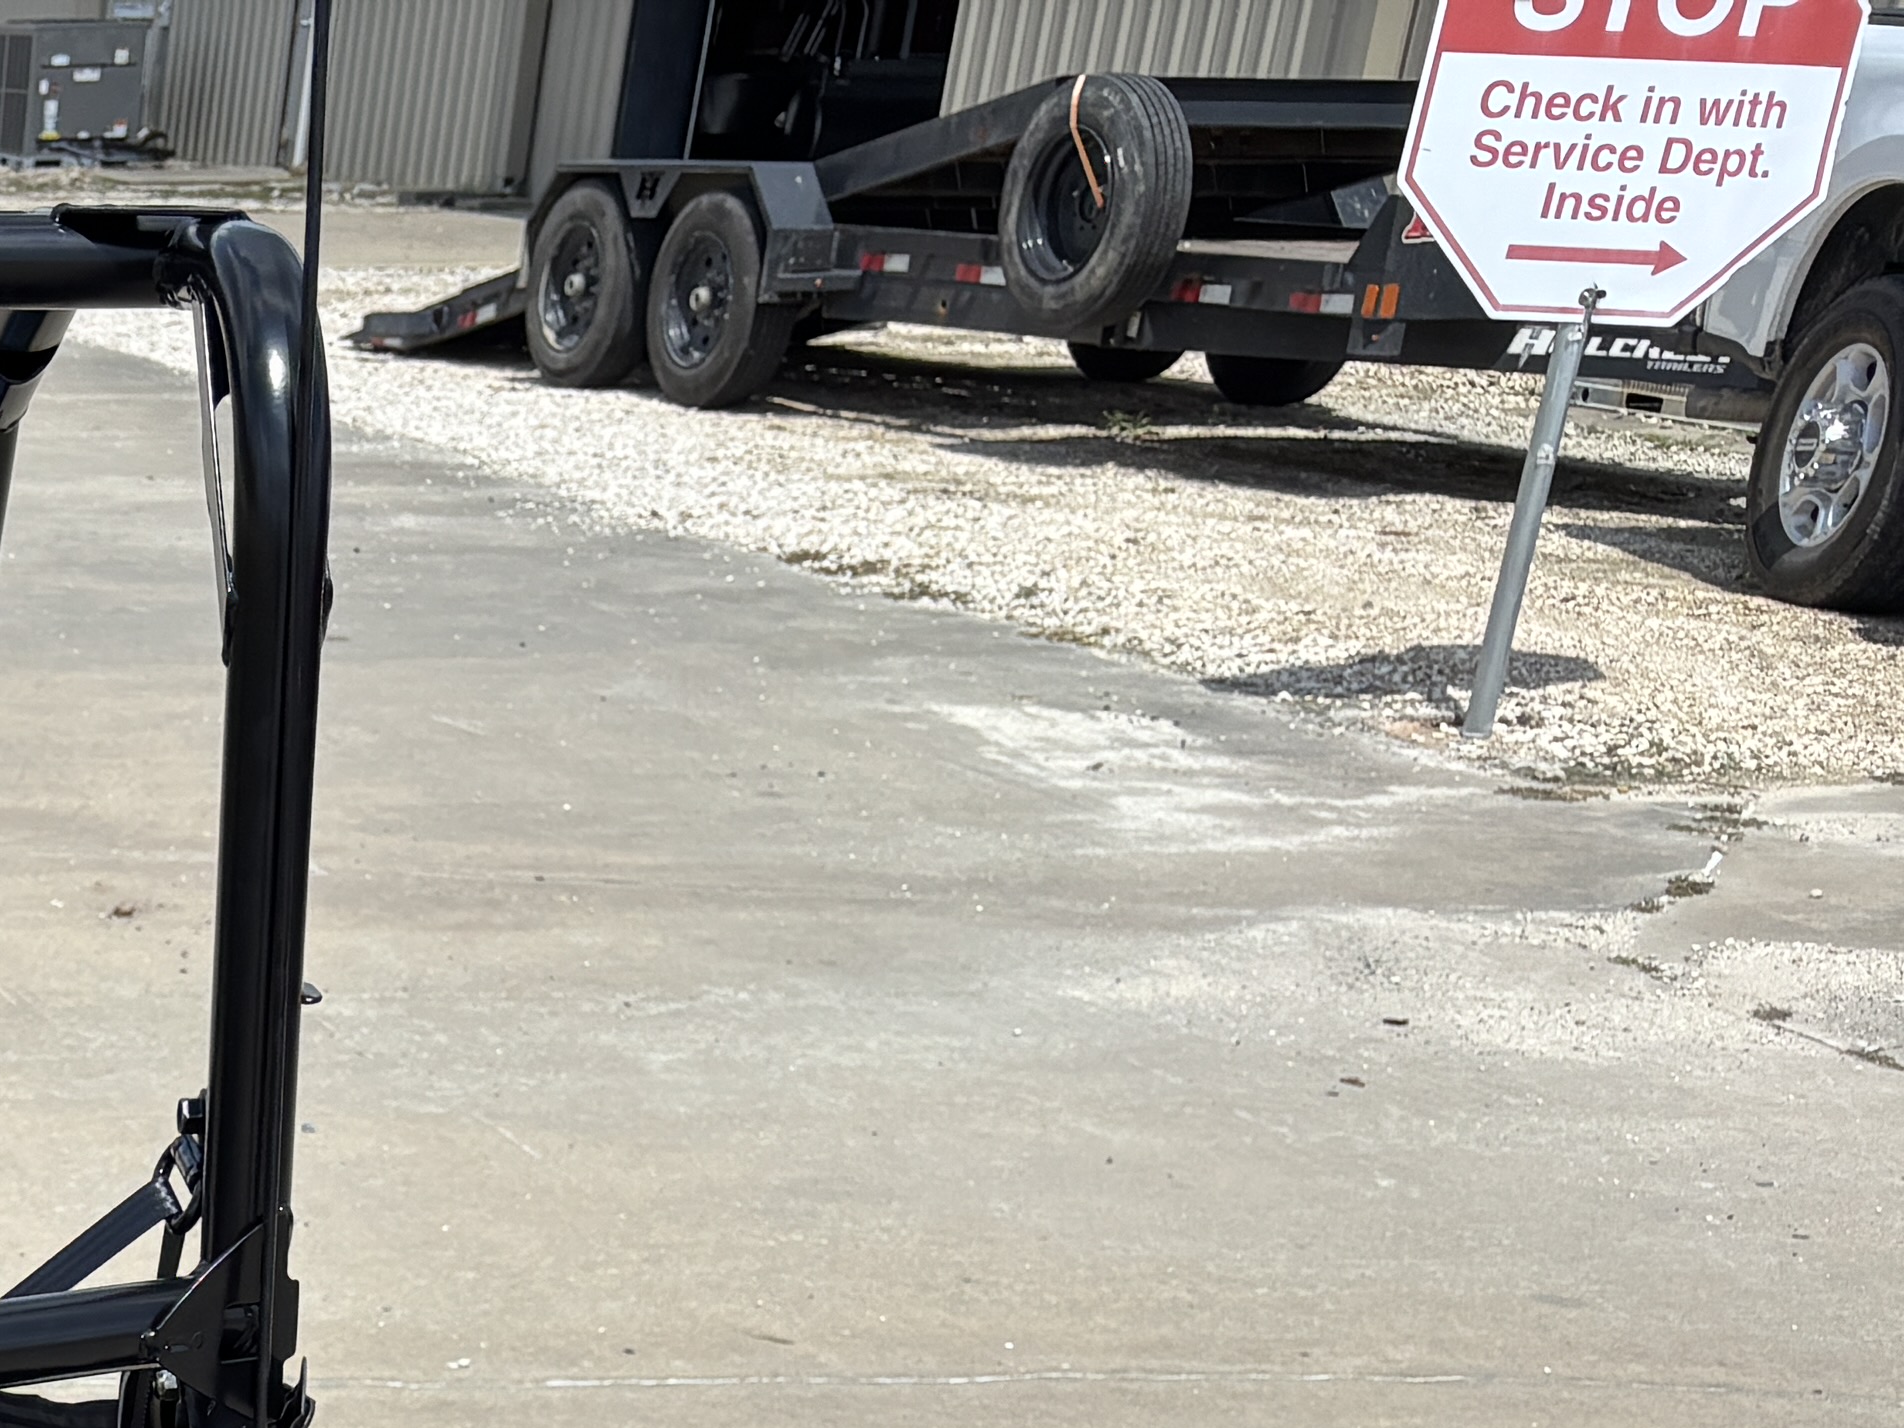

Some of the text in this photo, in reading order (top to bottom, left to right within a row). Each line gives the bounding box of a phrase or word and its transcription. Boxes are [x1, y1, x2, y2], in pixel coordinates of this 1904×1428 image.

[1480, 79, 1787, 128] Check in with
[1470, 130, 1770, 186] Service Dept.
[1540, 182, 1680, 223] Inside
